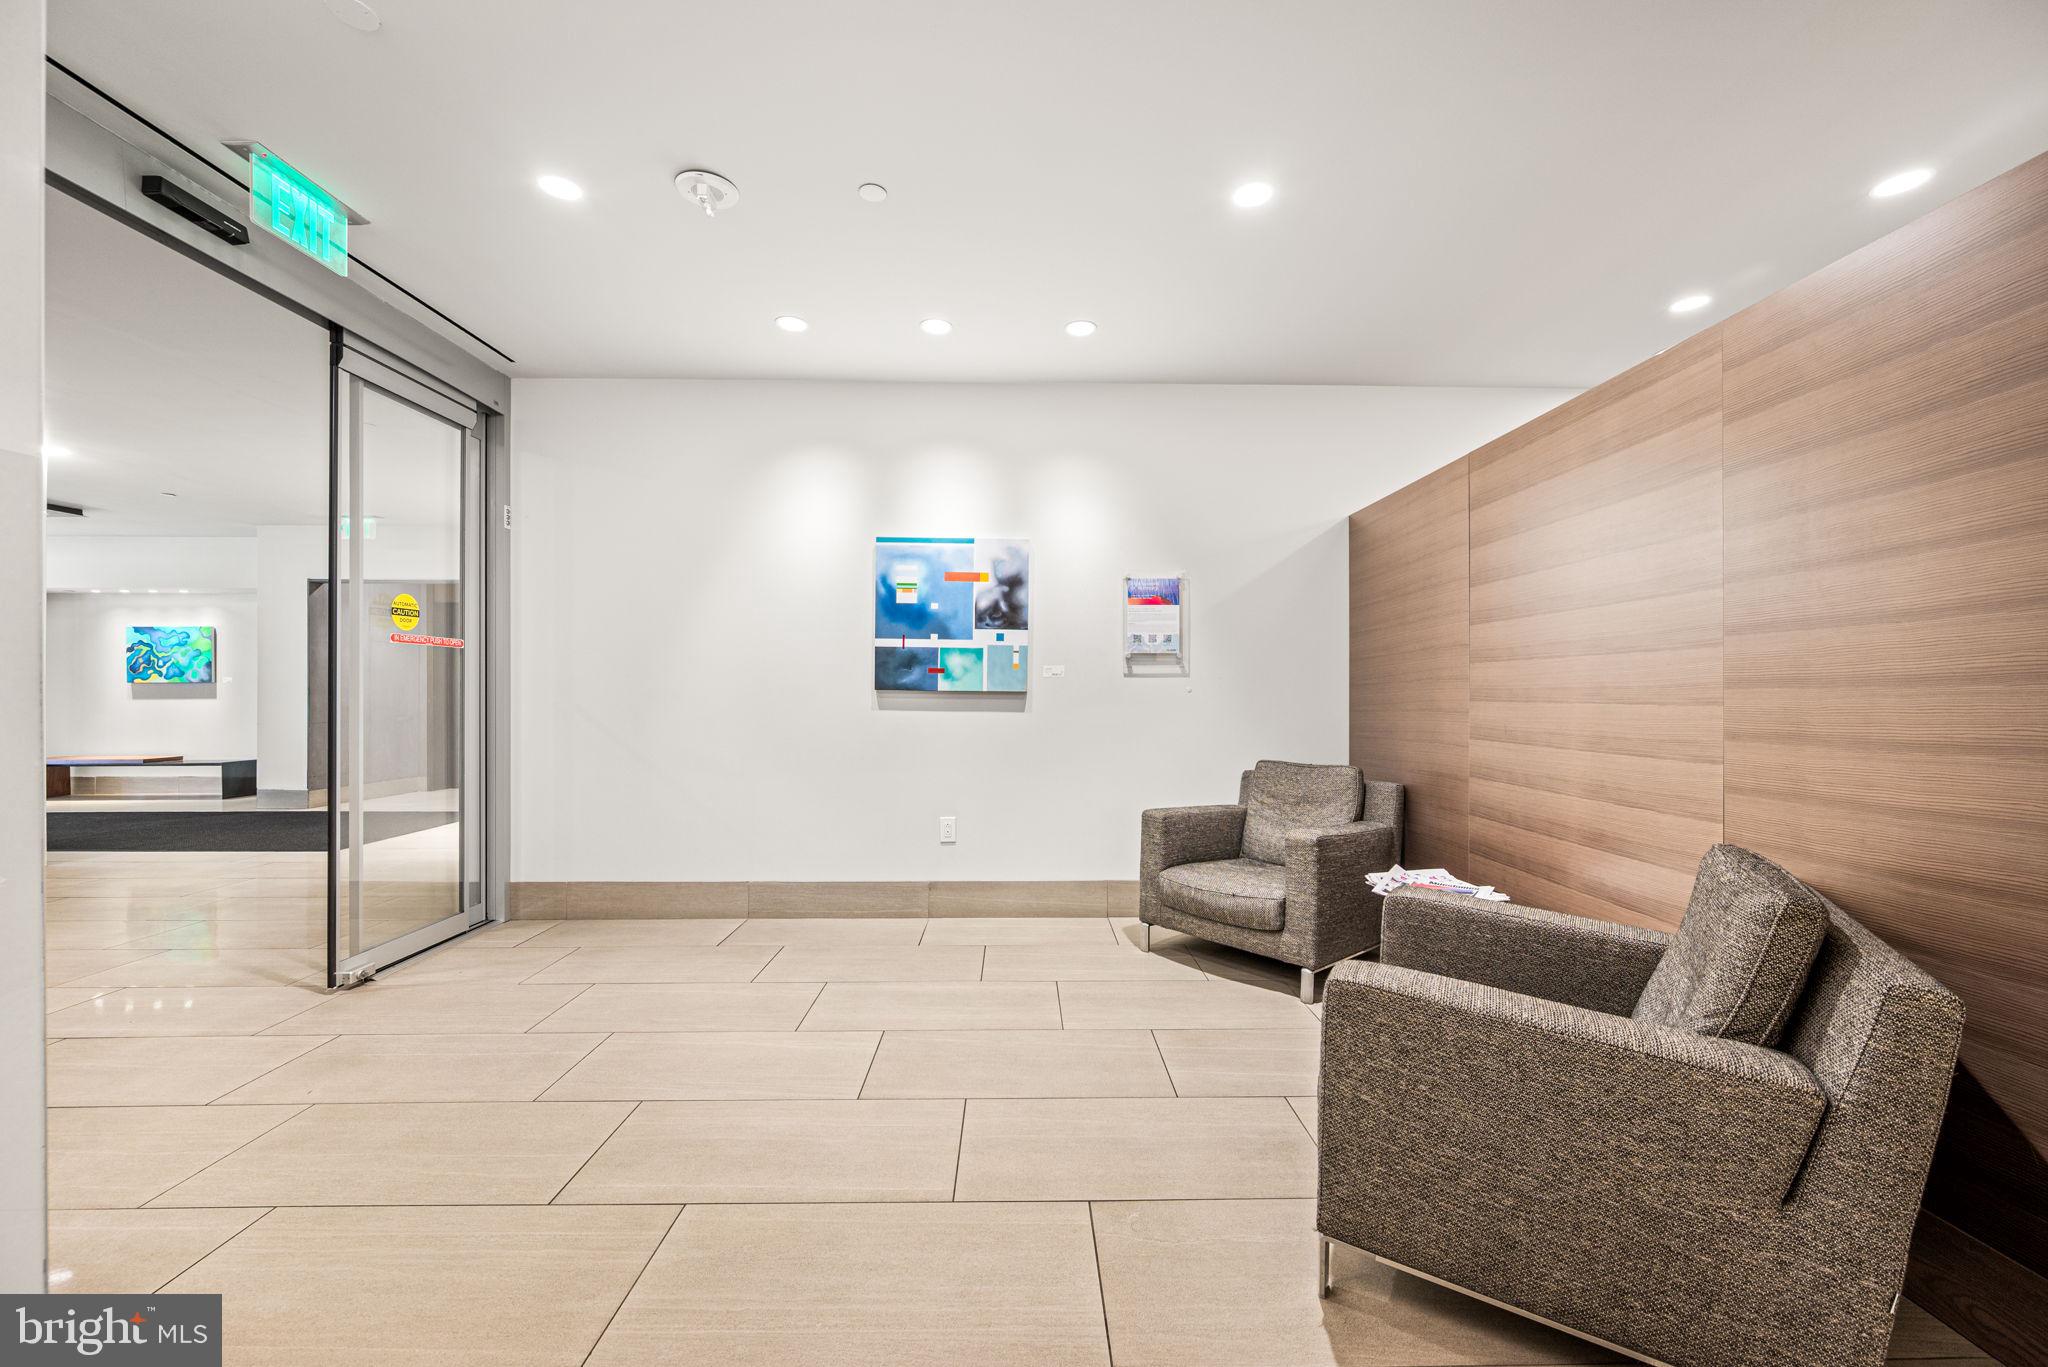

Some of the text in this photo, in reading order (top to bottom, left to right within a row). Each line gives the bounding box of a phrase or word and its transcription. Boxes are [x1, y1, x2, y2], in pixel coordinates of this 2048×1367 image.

[270, 172, 335, 263] EXIT
[393, 601, 418, 609] AUTOMATIC
[392, 608, 419, 617] CAUTION
[400, 634, 430, 643] EMERGENCY
[430, 636, 442, 645] PUSH
